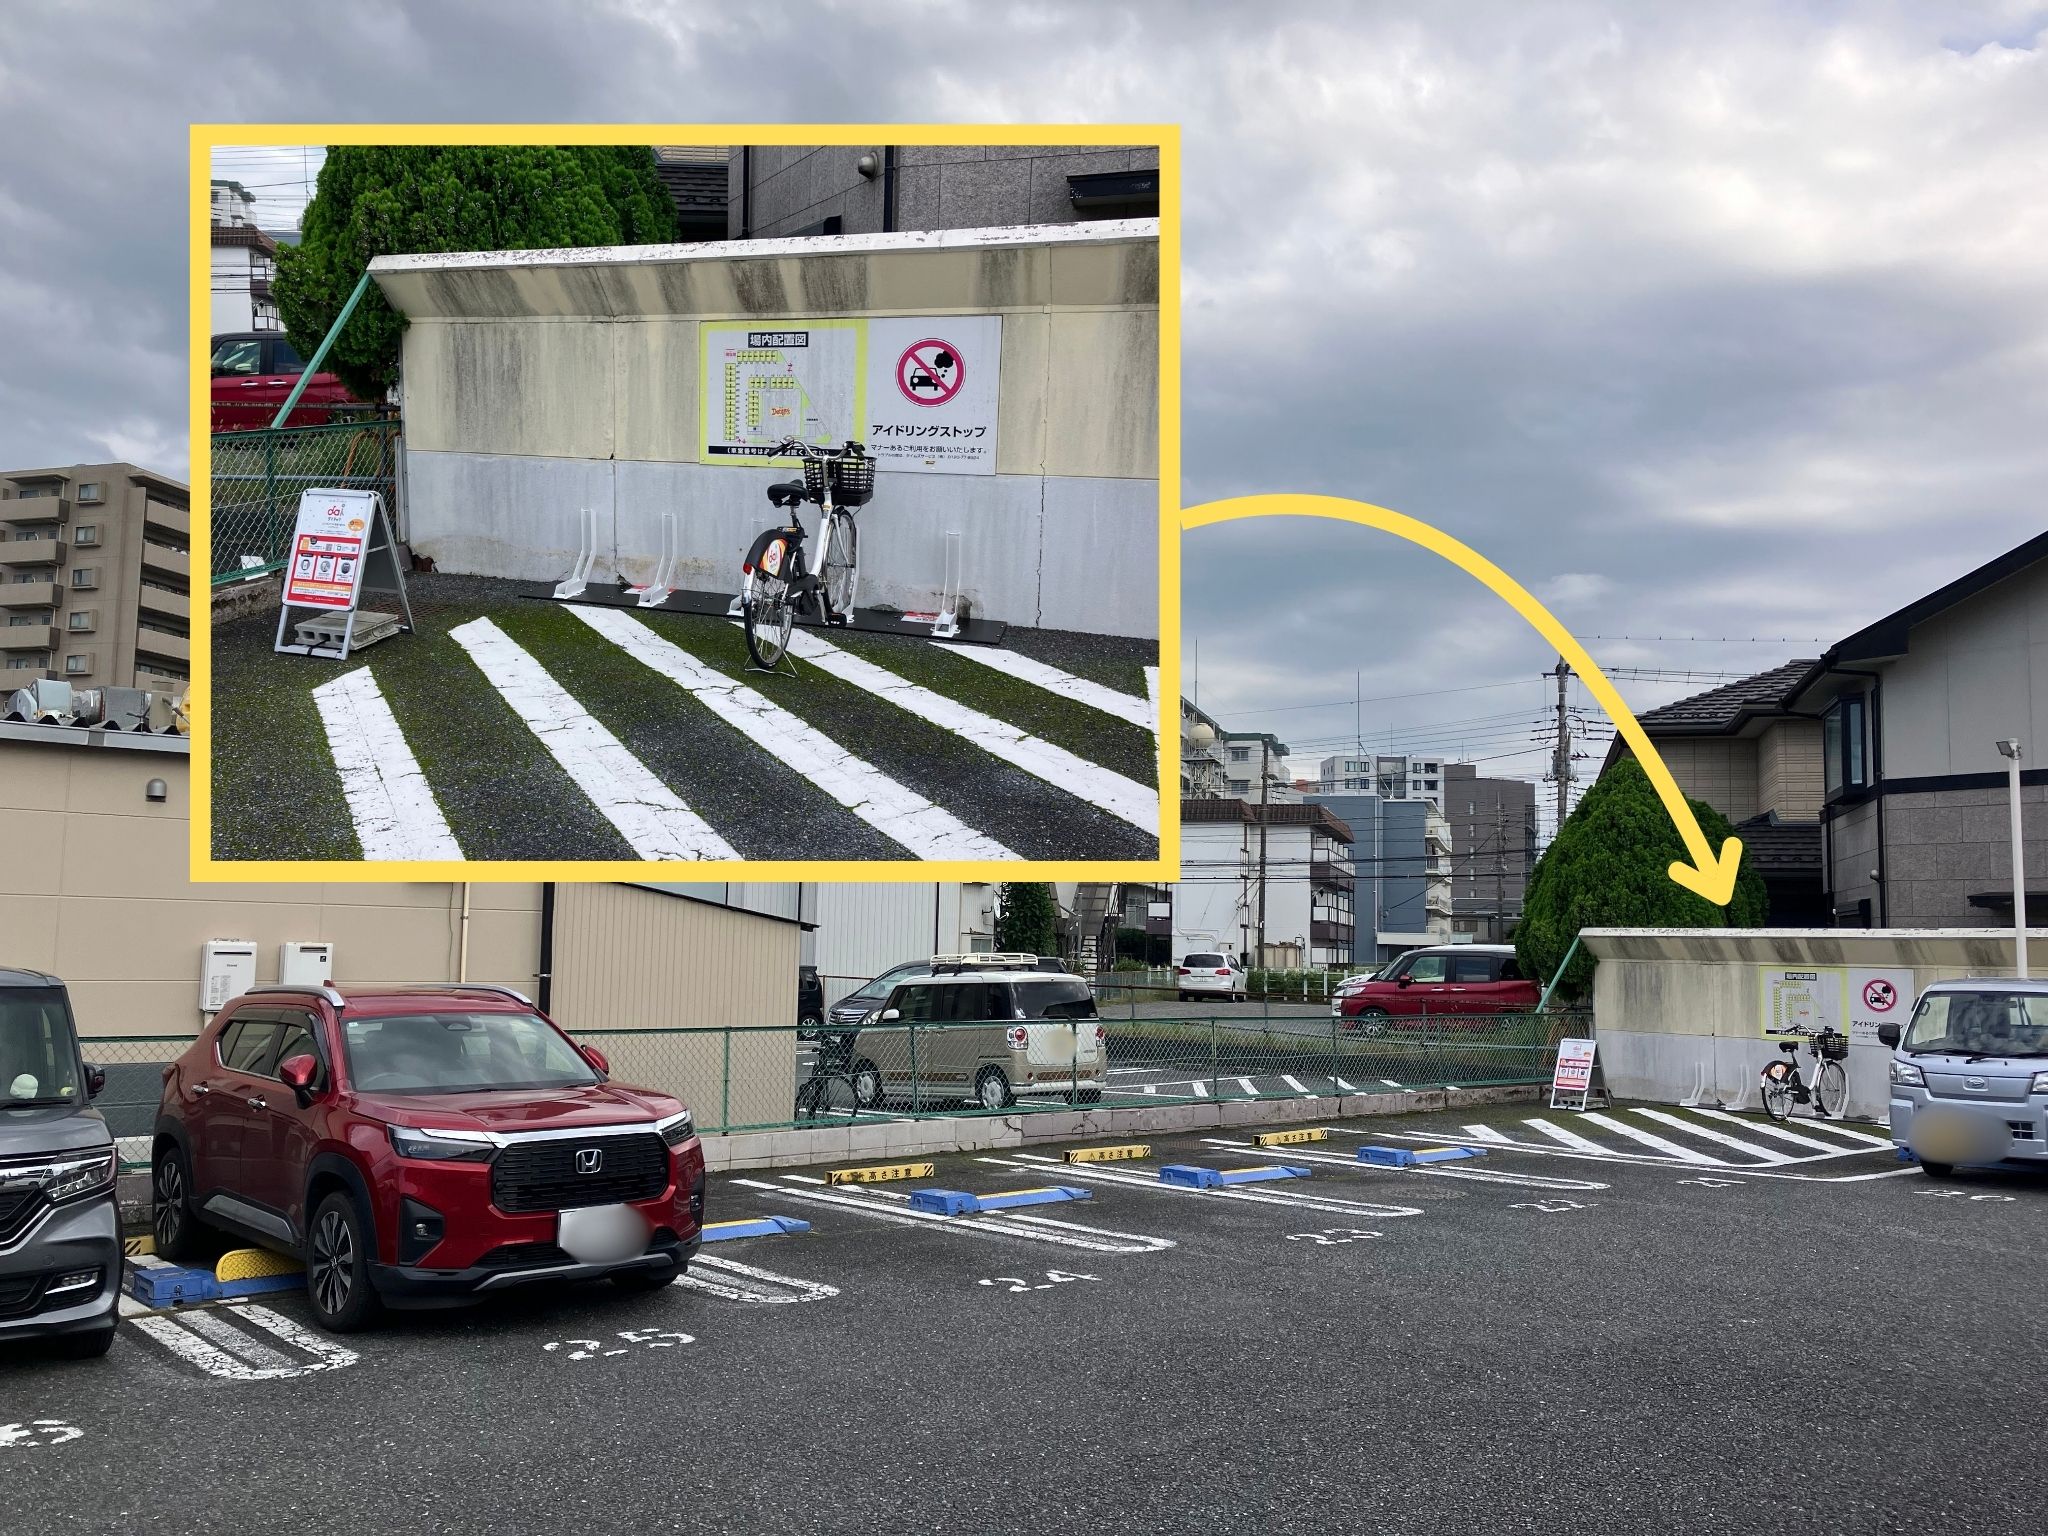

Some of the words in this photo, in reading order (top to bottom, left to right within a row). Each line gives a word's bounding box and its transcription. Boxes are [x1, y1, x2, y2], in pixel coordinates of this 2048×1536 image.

[750, 333, 807, 347] 場内配置図
[872, 425, 987, 438] アイドリングストップ
[1099, 1149, 1133, 1160] 高さ注意
[868, 1167, 912, 1181] 高さ注意
[978, 1269, 1102, 1293] 24
[542, 1327, 696, 1361] 25
